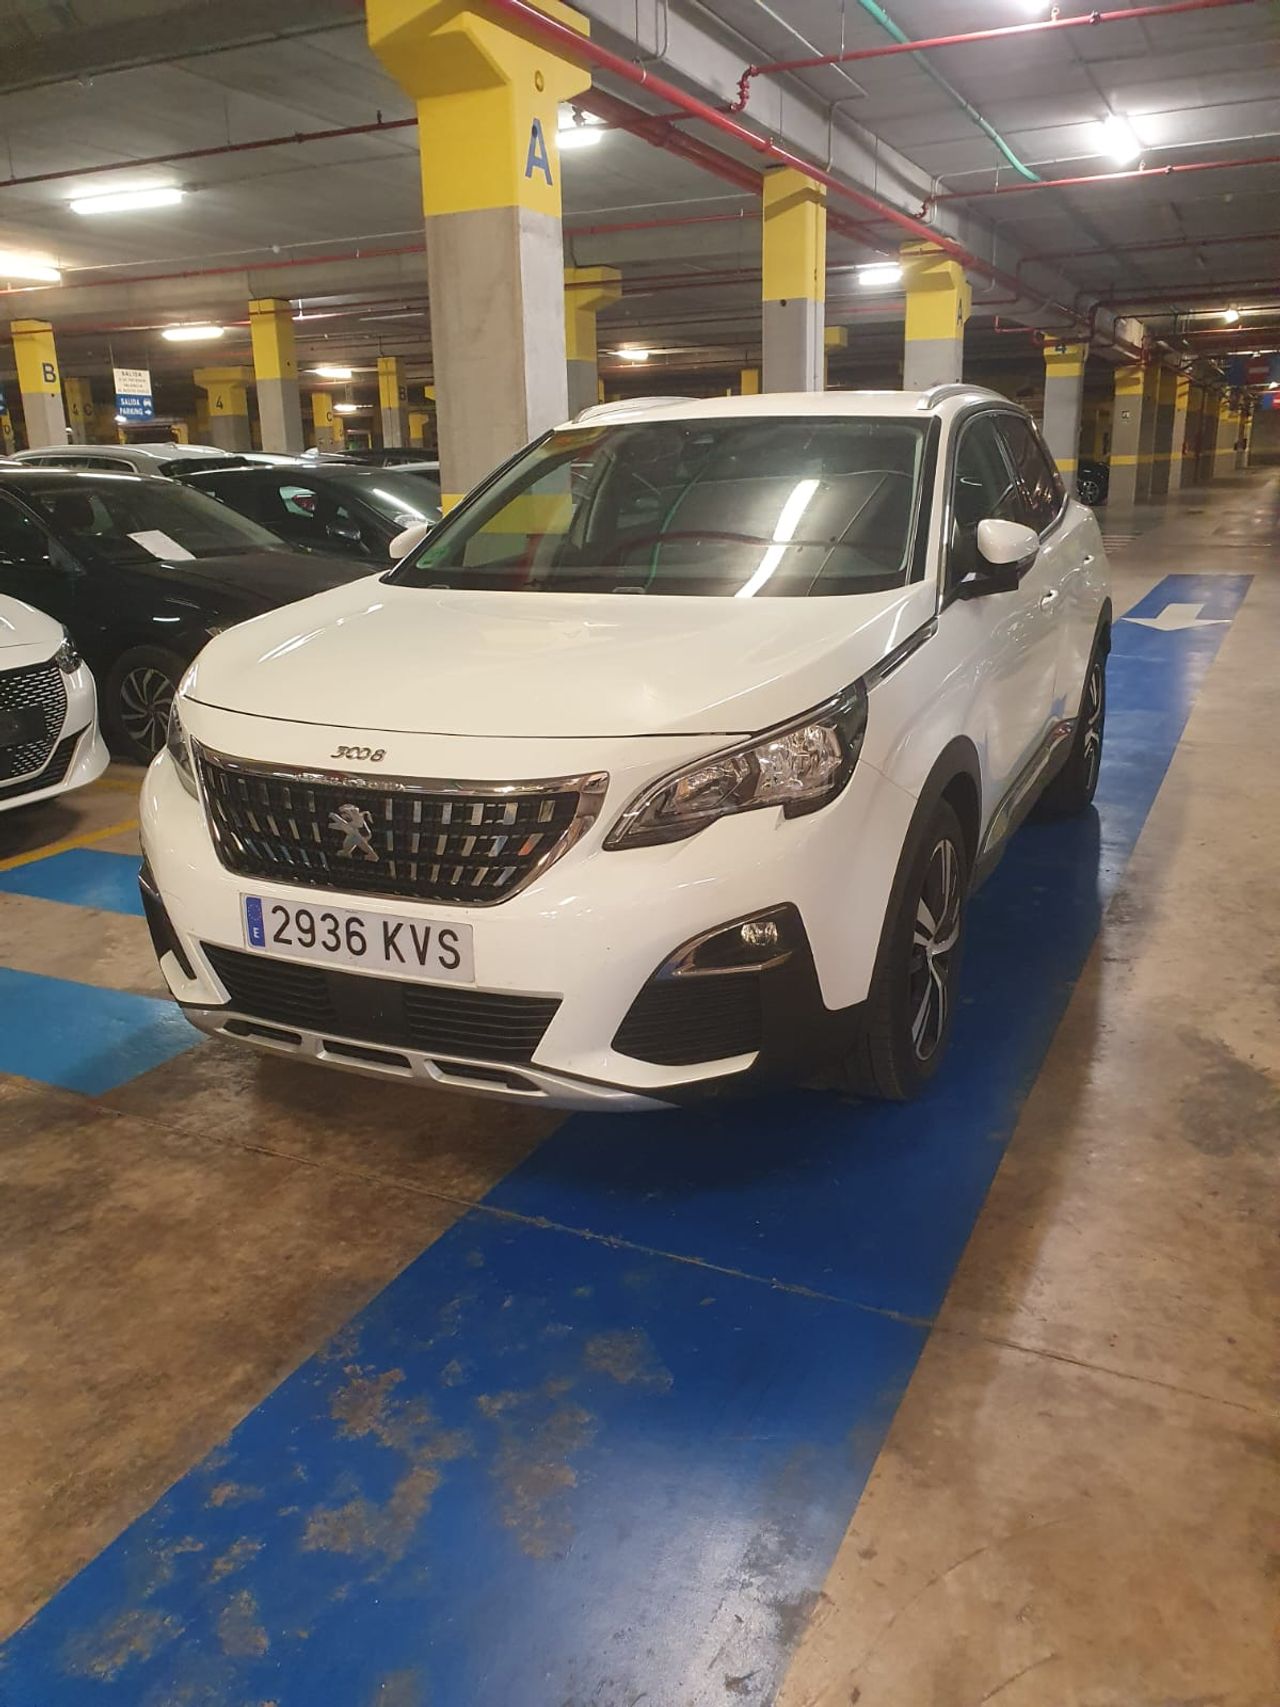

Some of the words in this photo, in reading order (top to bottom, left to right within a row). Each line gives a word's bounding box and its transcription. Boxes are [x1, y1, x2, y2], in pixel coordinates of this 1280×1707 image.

[525, 118, 553, 186] A
[43, 363, 56, 383] B
[120, 398, 140, 406] SALIDA
[216, 396, 223, 409] 4
[119, 407, 143, 415] PARKING
[330, 746, 387, 761] 3008
[253, 927, 260, 939] E
[271, 904, 367, 956] 2936
[383, 921, 460, 970] KVS
